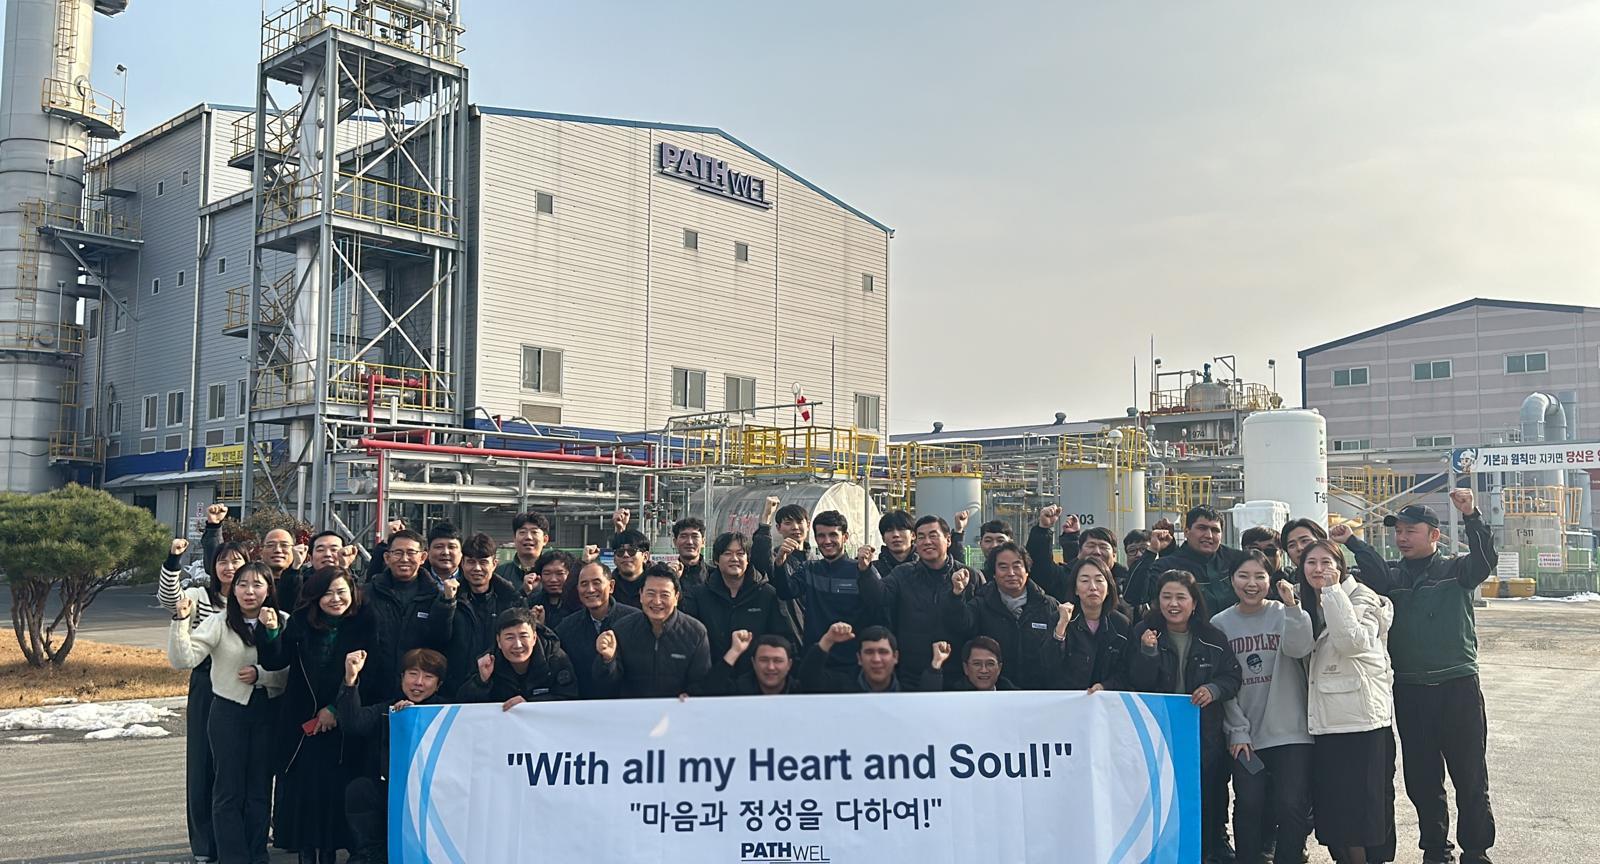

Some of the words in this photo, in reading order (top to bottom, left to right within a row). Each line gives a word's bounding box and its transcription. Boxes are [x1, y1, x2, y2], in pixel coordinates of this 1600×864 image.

[1483, 453, 1508, 466] 기본과
[1511, 452, 1537, 465] 원칙만
[1539, 452, 1563, 464] 지키면
[1566, 449, 1594, 463] 당신은
[507, 751, 609, 787] "With
[622, 749, 666, 785] all
[679, 757, 736, 792] my
[749, 748, 852, 781] Heart
[864, 744, 936, 780] and
[949, 743, 1072, 779] Soul!"
[630, 800, 728, 833] "마음과
[739, 799, 823, 832] 정성을
[835, 797, 942, 831] 다하여!"
